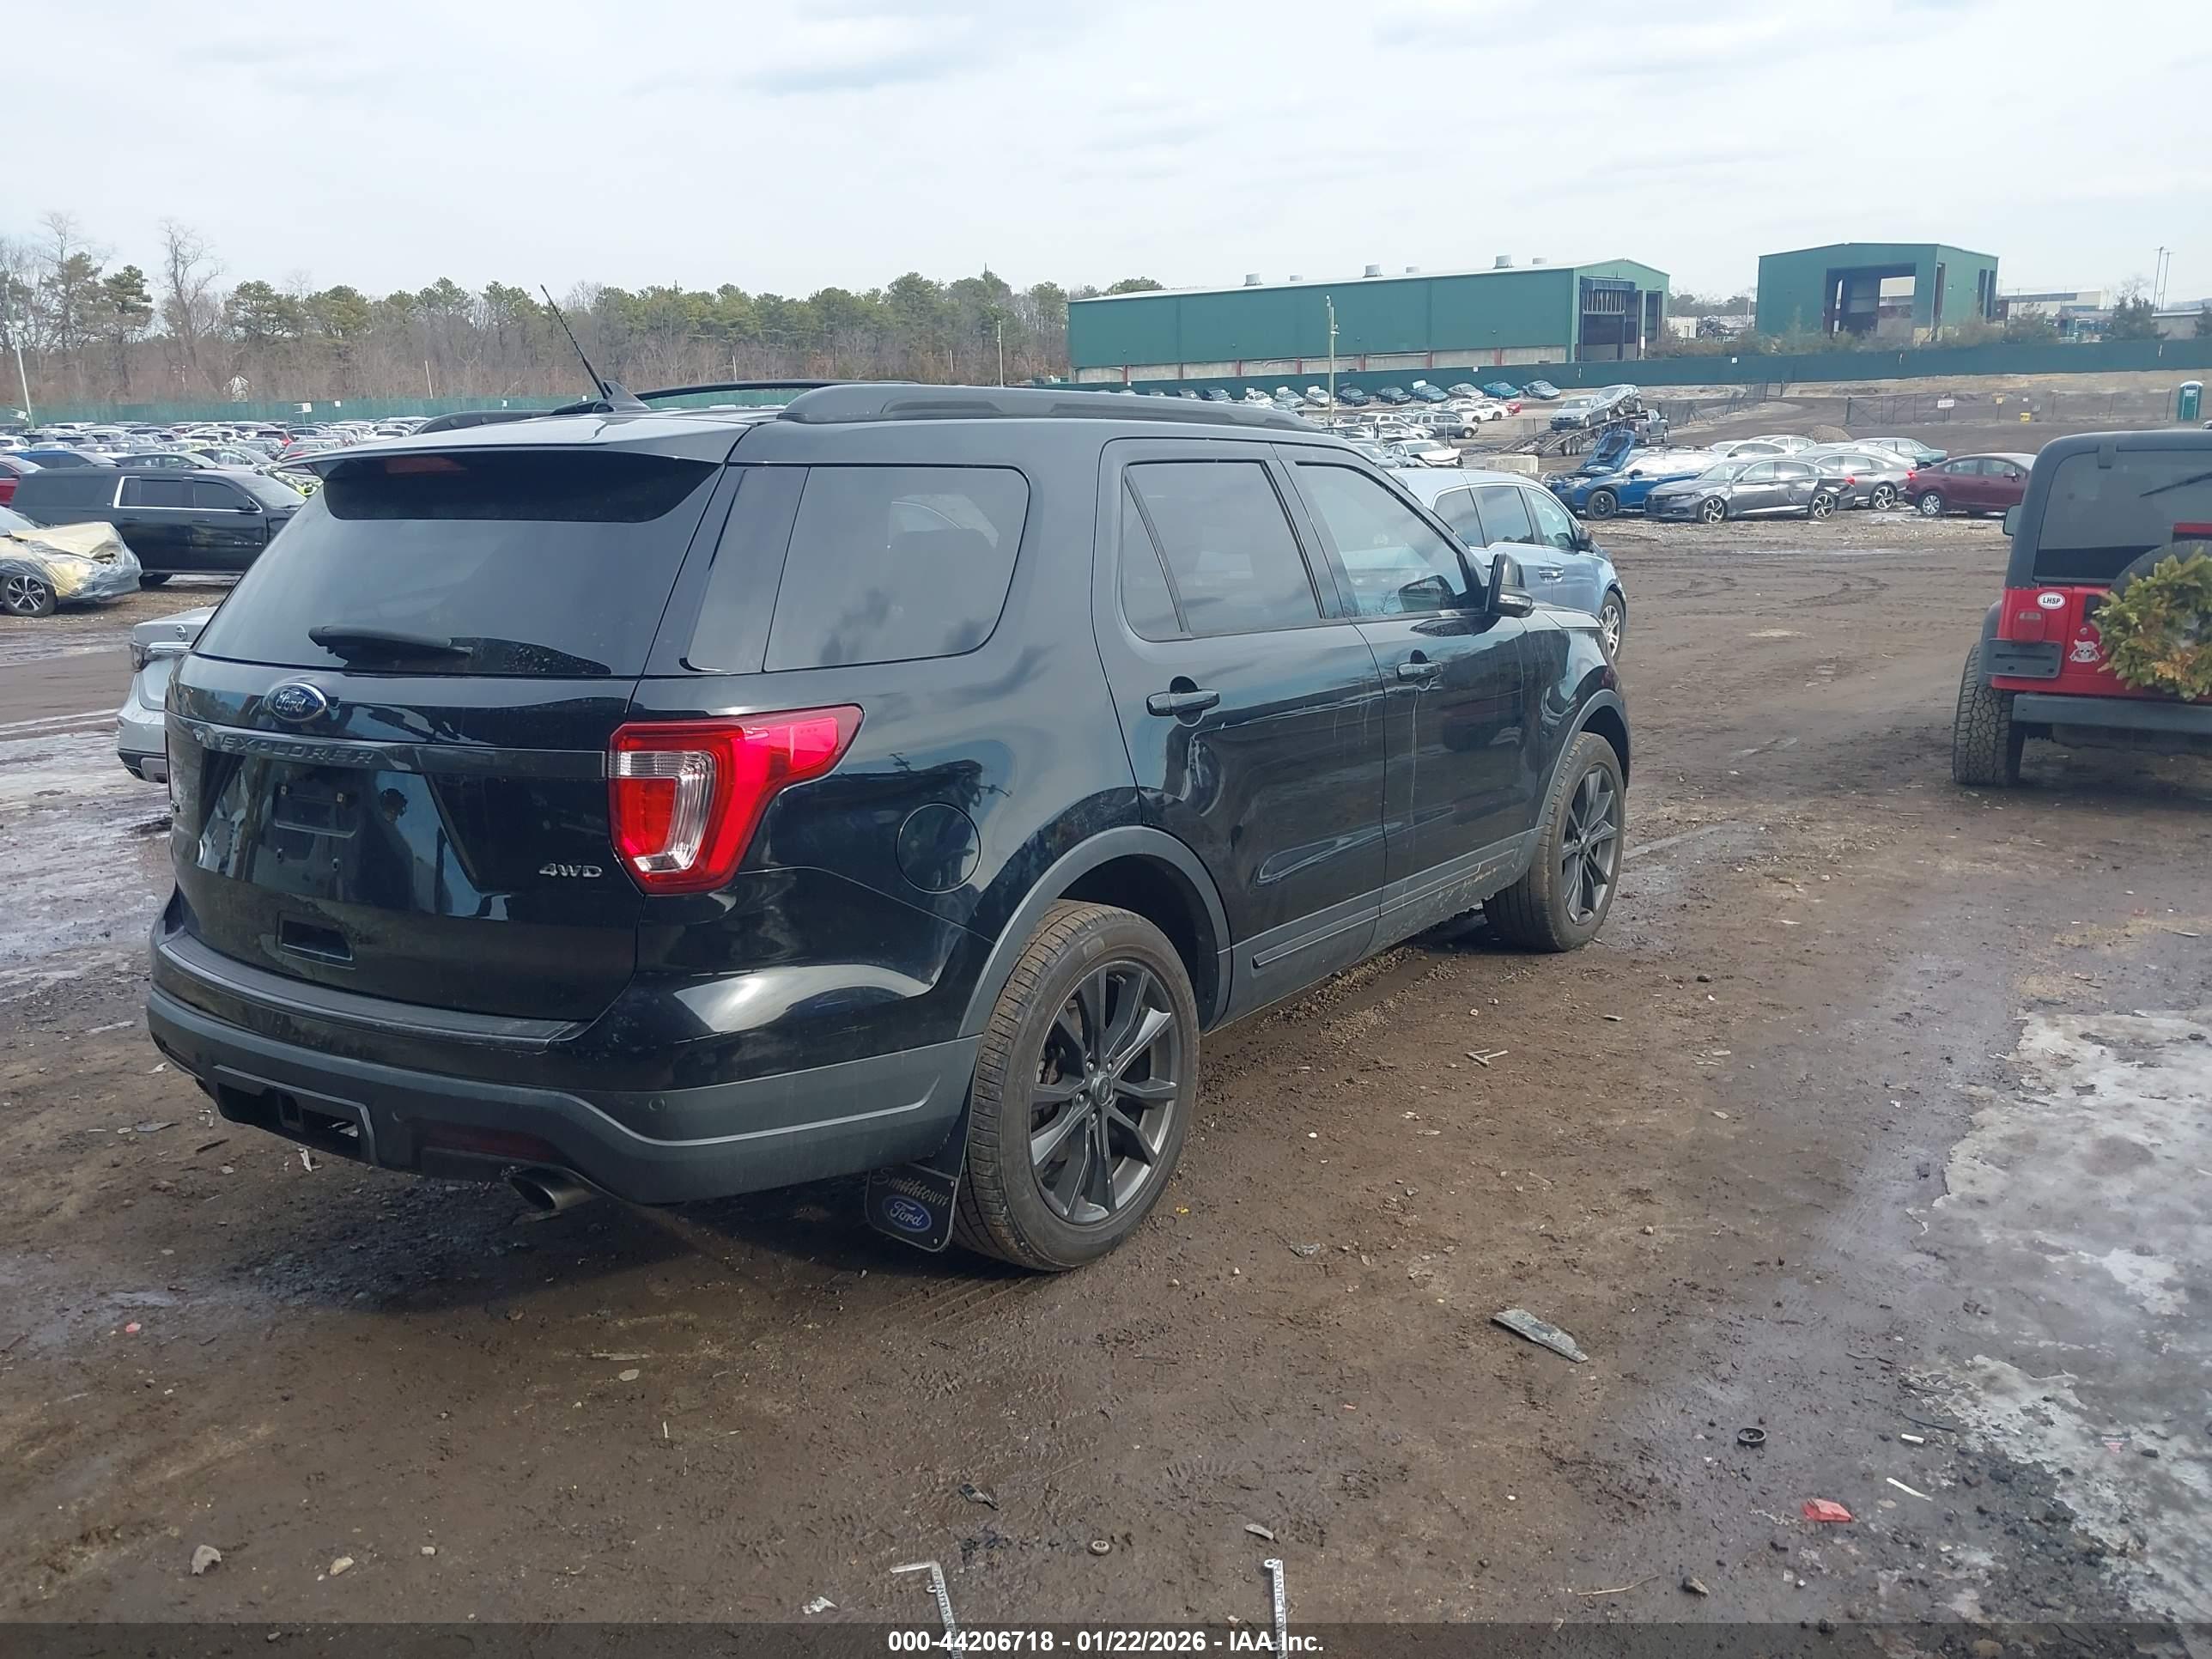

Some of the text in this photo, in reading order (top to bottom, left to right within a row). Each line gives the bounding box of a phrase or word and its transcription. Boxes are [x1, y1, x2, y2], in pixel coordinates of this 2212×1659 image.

[276, 689, 307, 713] Ford
[222, 736, 374, 763] EXPLORER
[538, 862, 603, 878] 4WD
[871, 1167, 950, 1206] Smithtown
[889, 1200, 925, 1227] Ford
